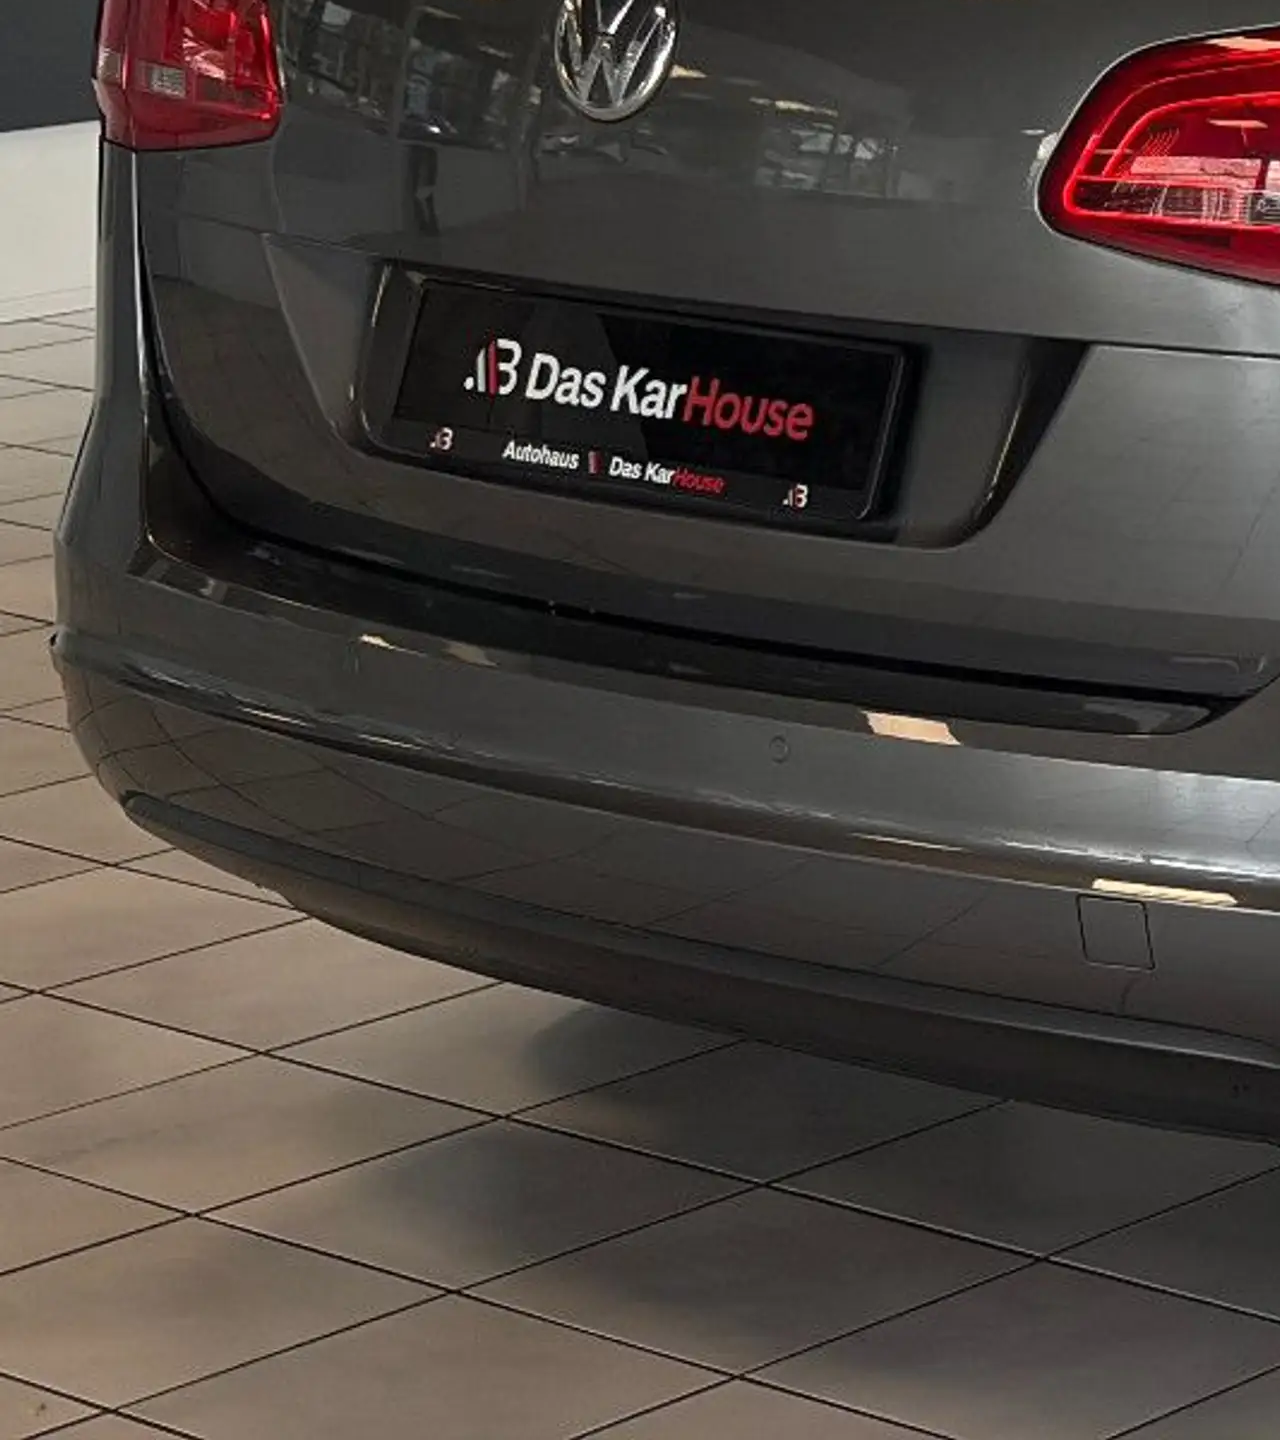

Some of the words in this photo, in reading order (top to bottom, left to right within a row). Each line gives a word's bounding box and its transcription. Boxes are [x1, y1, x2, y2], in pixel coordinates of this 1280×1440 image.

[525, 352, 606, 409] Das
[610, 364, 815, 441] KarHouse
[503, 440, 580, 470] Autohaus
[609, 455, 643, 481] Das
[644, 462, 726, 494] KarHouse
